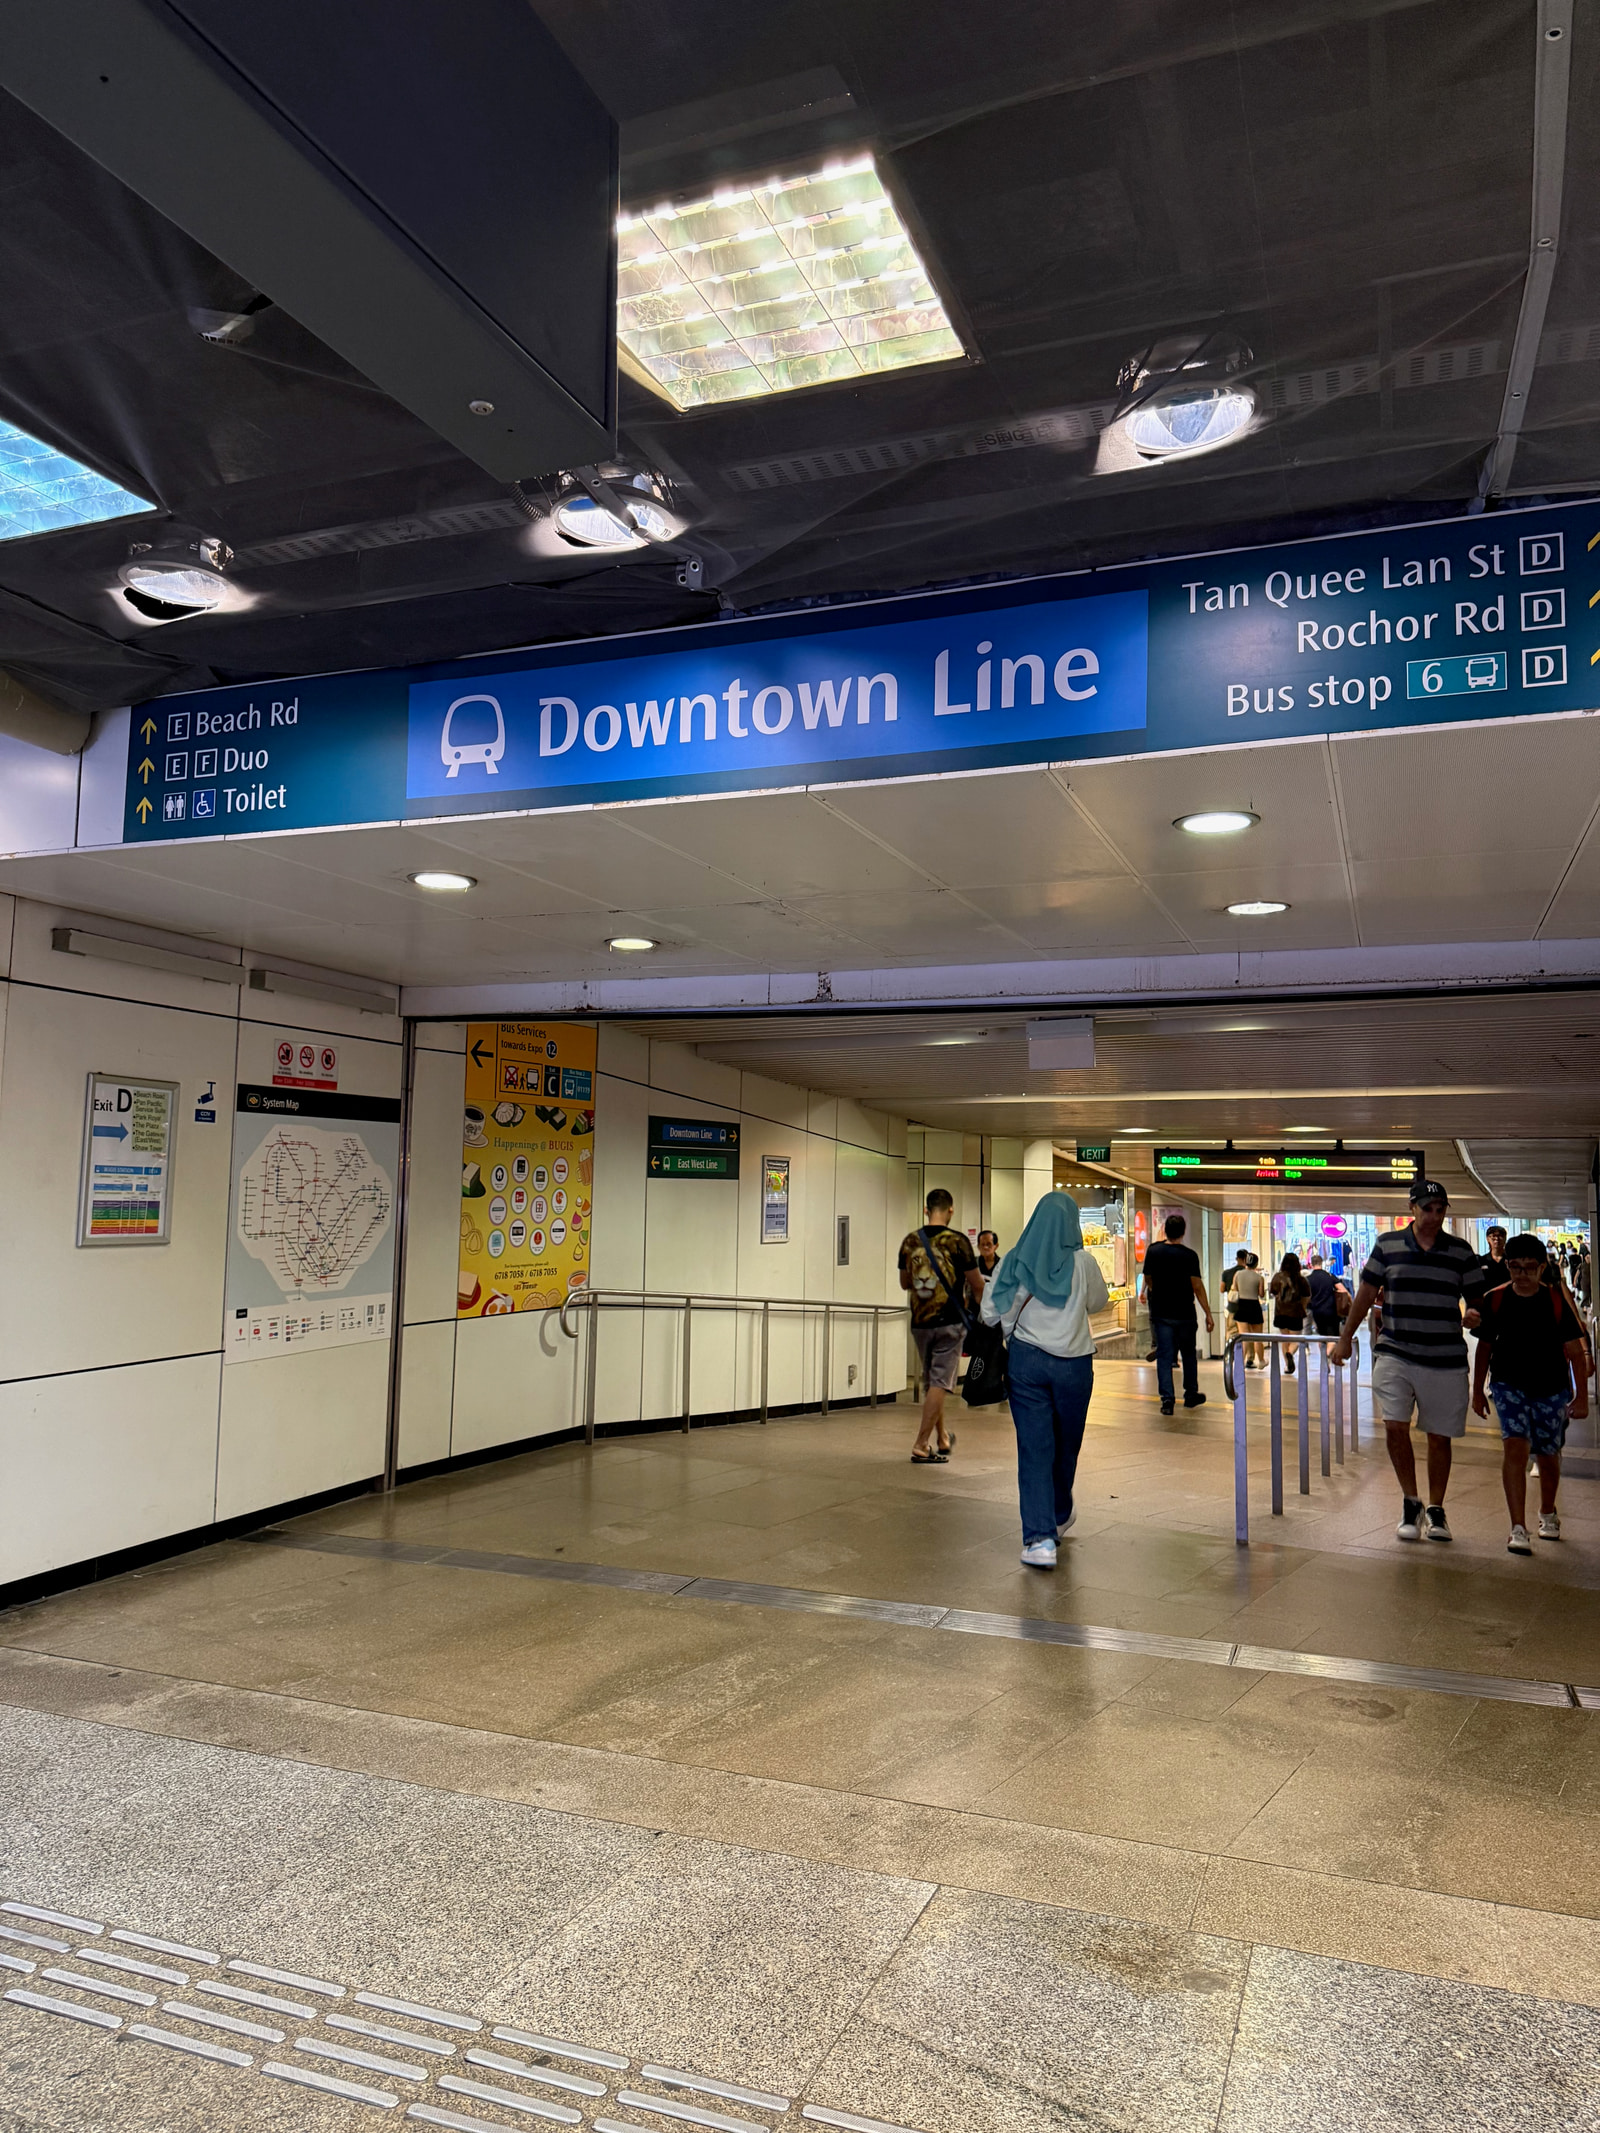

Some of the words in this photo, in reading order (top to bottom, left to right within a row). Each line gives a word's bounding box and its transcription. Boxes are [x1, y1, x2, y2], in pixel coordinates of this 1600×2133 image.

[1182, 580, 1249, 614] Tan
[1265, 567, 1366, 608] Quee
[1382, 555, 1451, 589] Lan
[1468, 543, 1505, 579] St
[1531, 542, 1552, 567] D
[1298, 610, 1438, 653] Rochor
[1455, 595, 1504, 636] Rd
[1532, 598, 1553, 622] D
[1227, 683, 1294, 717] Bus
[1308, 673, 1392, 710] stop
[1421, 662, 1443, 693] 6
[1534, 655, 1555, 679] D
[539, 672, 898, 757] Downtown
[933, 641, 1100, 717] Line
[174, 718, 183, 736] E
[196, 703, 261, 736] Beach
[270, 697, 299, 727] Rd
[172, 758, 181, 775] E
[201, 755, 211, 772] F
[223, 748, 269, 772] Duo
[223, 783, 287, 813] Toilet
[501, 1023, 515, 1034] Bus
[517, 1024, 547, 1039] Services
[501, 1040, 526, 1051] towards
[528, 1042, 543, 1055] Expo
[547, 1043, 557, 1056] 12
[547, 1076, 557, 1095] C
[93, 1099, 113, 1112] Exit
[117, 1088, 132, 1112] D
[262, 1097, 285, 1109] System
[286, 1099, 299, 1111] Map
[669, 1127, 700, 1139] Downtown
[700, 1129, 713, 1140] Line
[493, 1137, 538, 1152] Happenings
[549, 1140, 574, 1151] BUGIS
[1086, 1149, 1106, 1160] EXIT
[677, 1158, 690, 1169] East
[690, 1159, 705, 1169] West
[706, 1159, 718, 1169] Line
